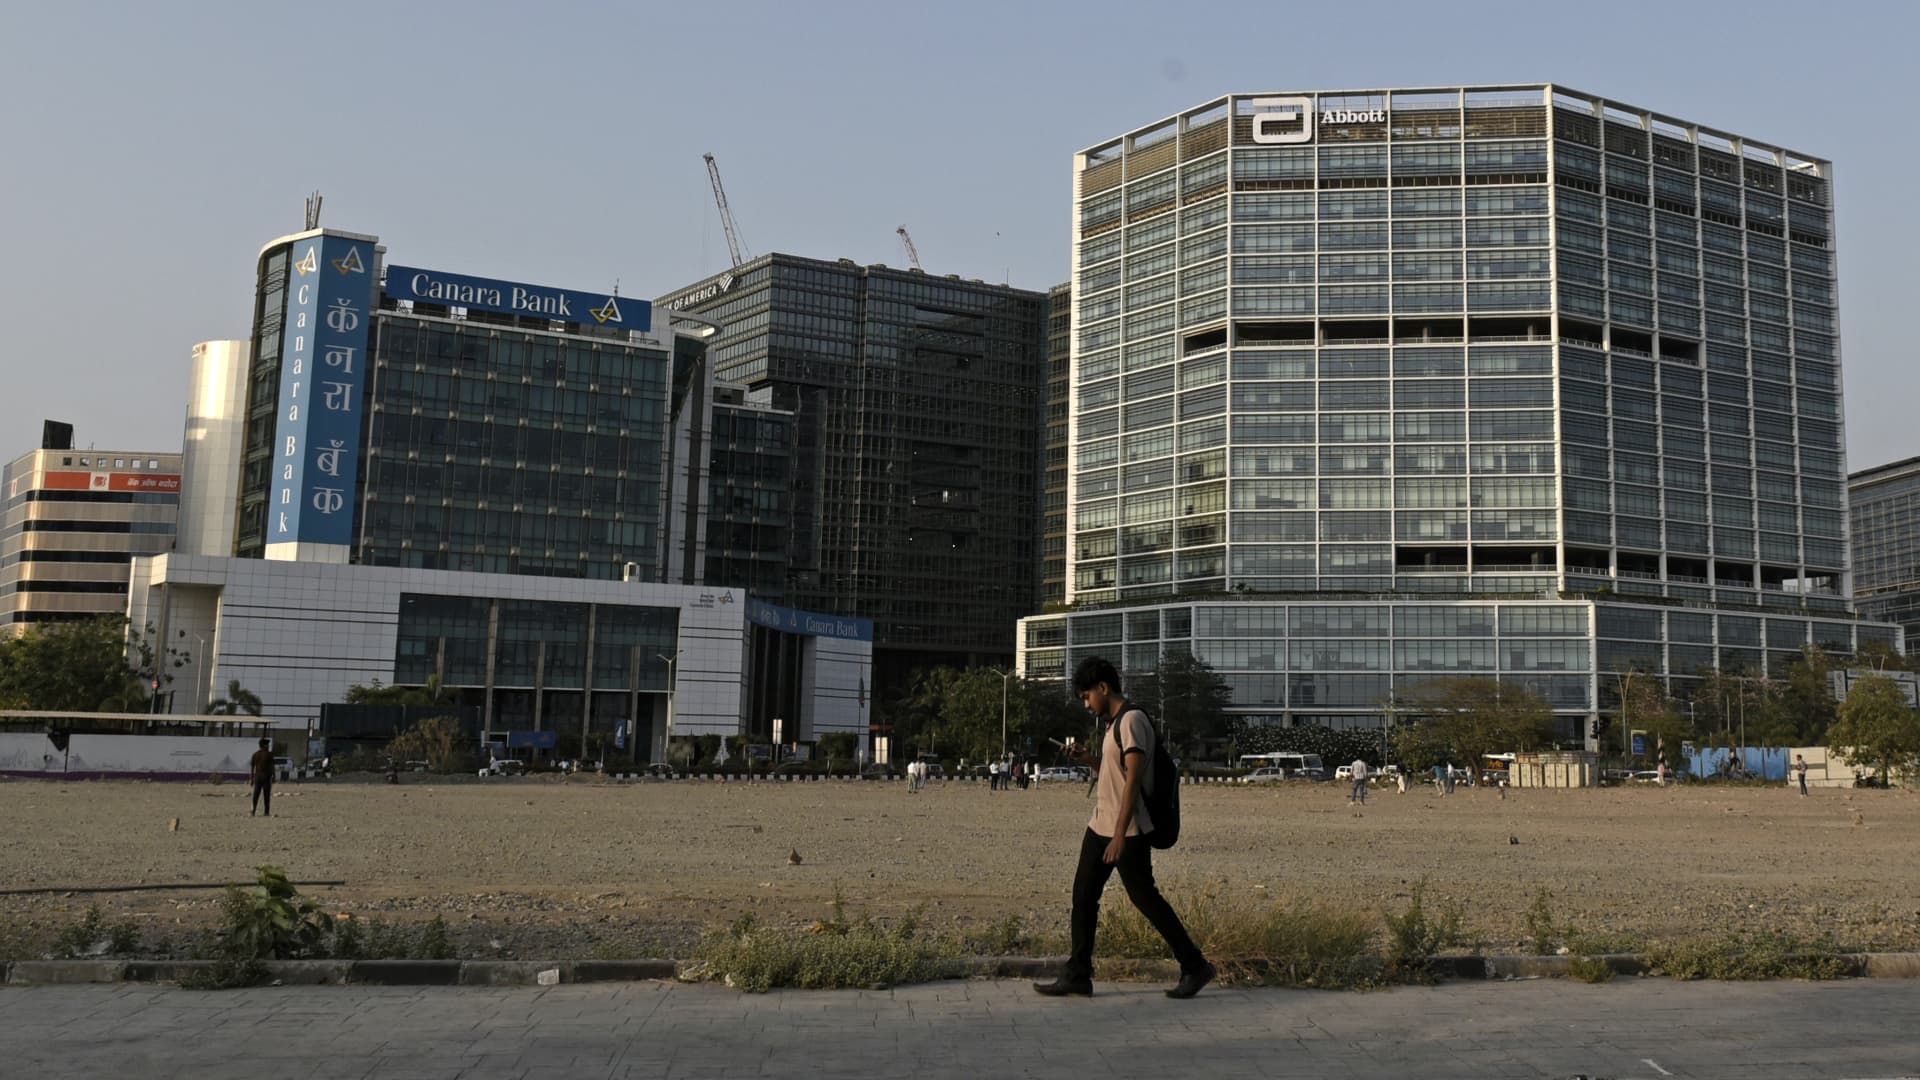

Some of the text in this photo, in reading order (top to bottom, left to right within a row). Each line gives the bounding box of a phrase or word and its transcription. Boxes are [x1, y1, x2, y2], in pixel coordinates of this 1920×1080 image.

[1321, 109, 1385, 124] Abbott
[411, 273, 571, 316] Canara Bank
[684, 284, 717, 308] AMERICA
[279, 284, 309, 532] Canara Bank
[806, 615, 858, 638] Canara Bank
